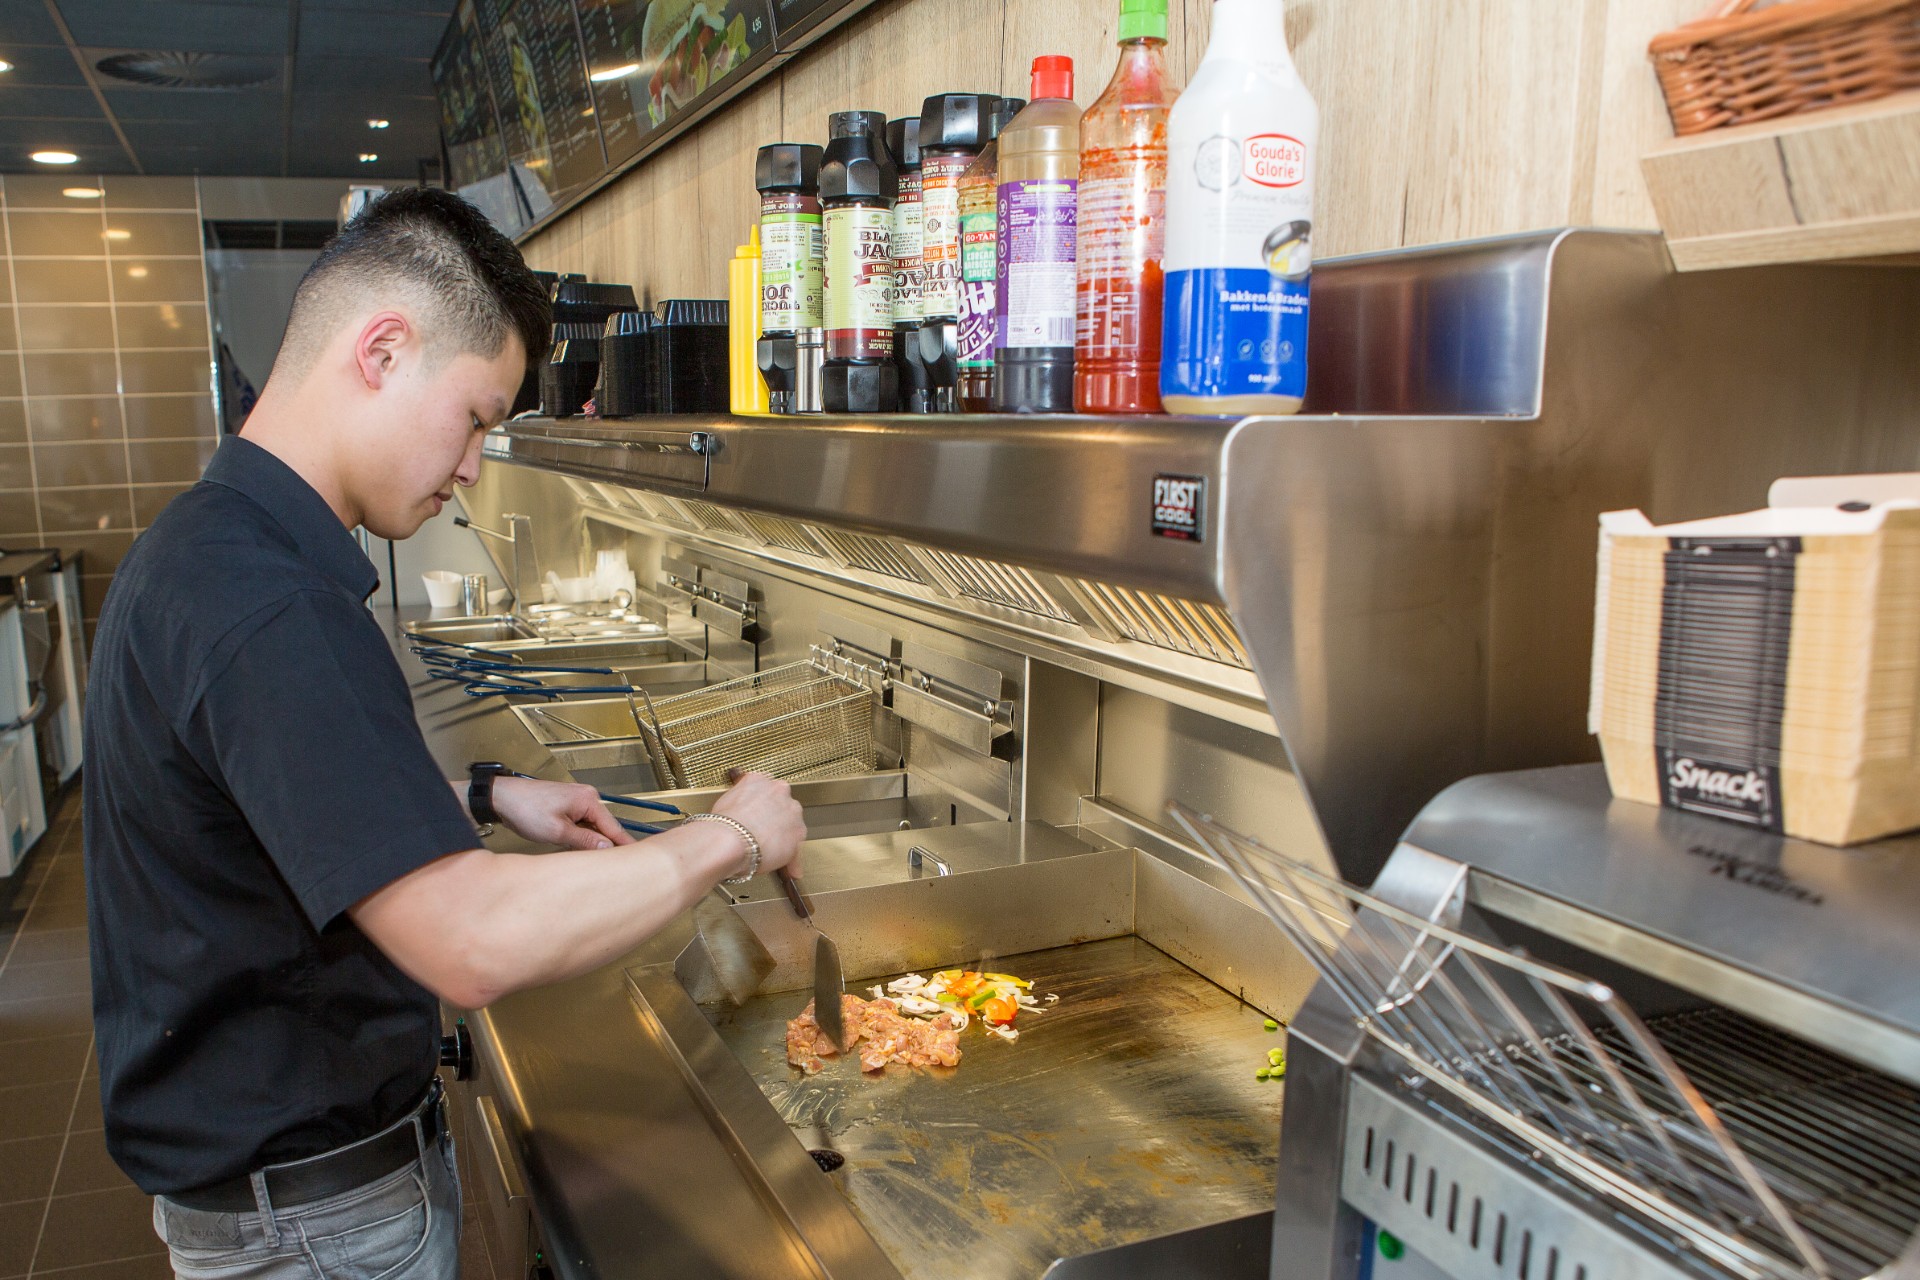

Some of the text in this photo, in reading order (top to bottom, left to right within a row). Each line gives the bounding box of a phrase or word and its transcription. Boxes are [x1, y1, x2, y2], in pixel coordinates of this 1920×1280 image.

[1250, 142, 1300, 162] Gouda's
[1255, 161, 1295, 178] Glorie
[968, 268, 992, 278] SAUCE
[1230, 303, 1250, 312] met
[1155, 506, 1195, 525] COOL
[1669, 757, 1765, 802] Snack
